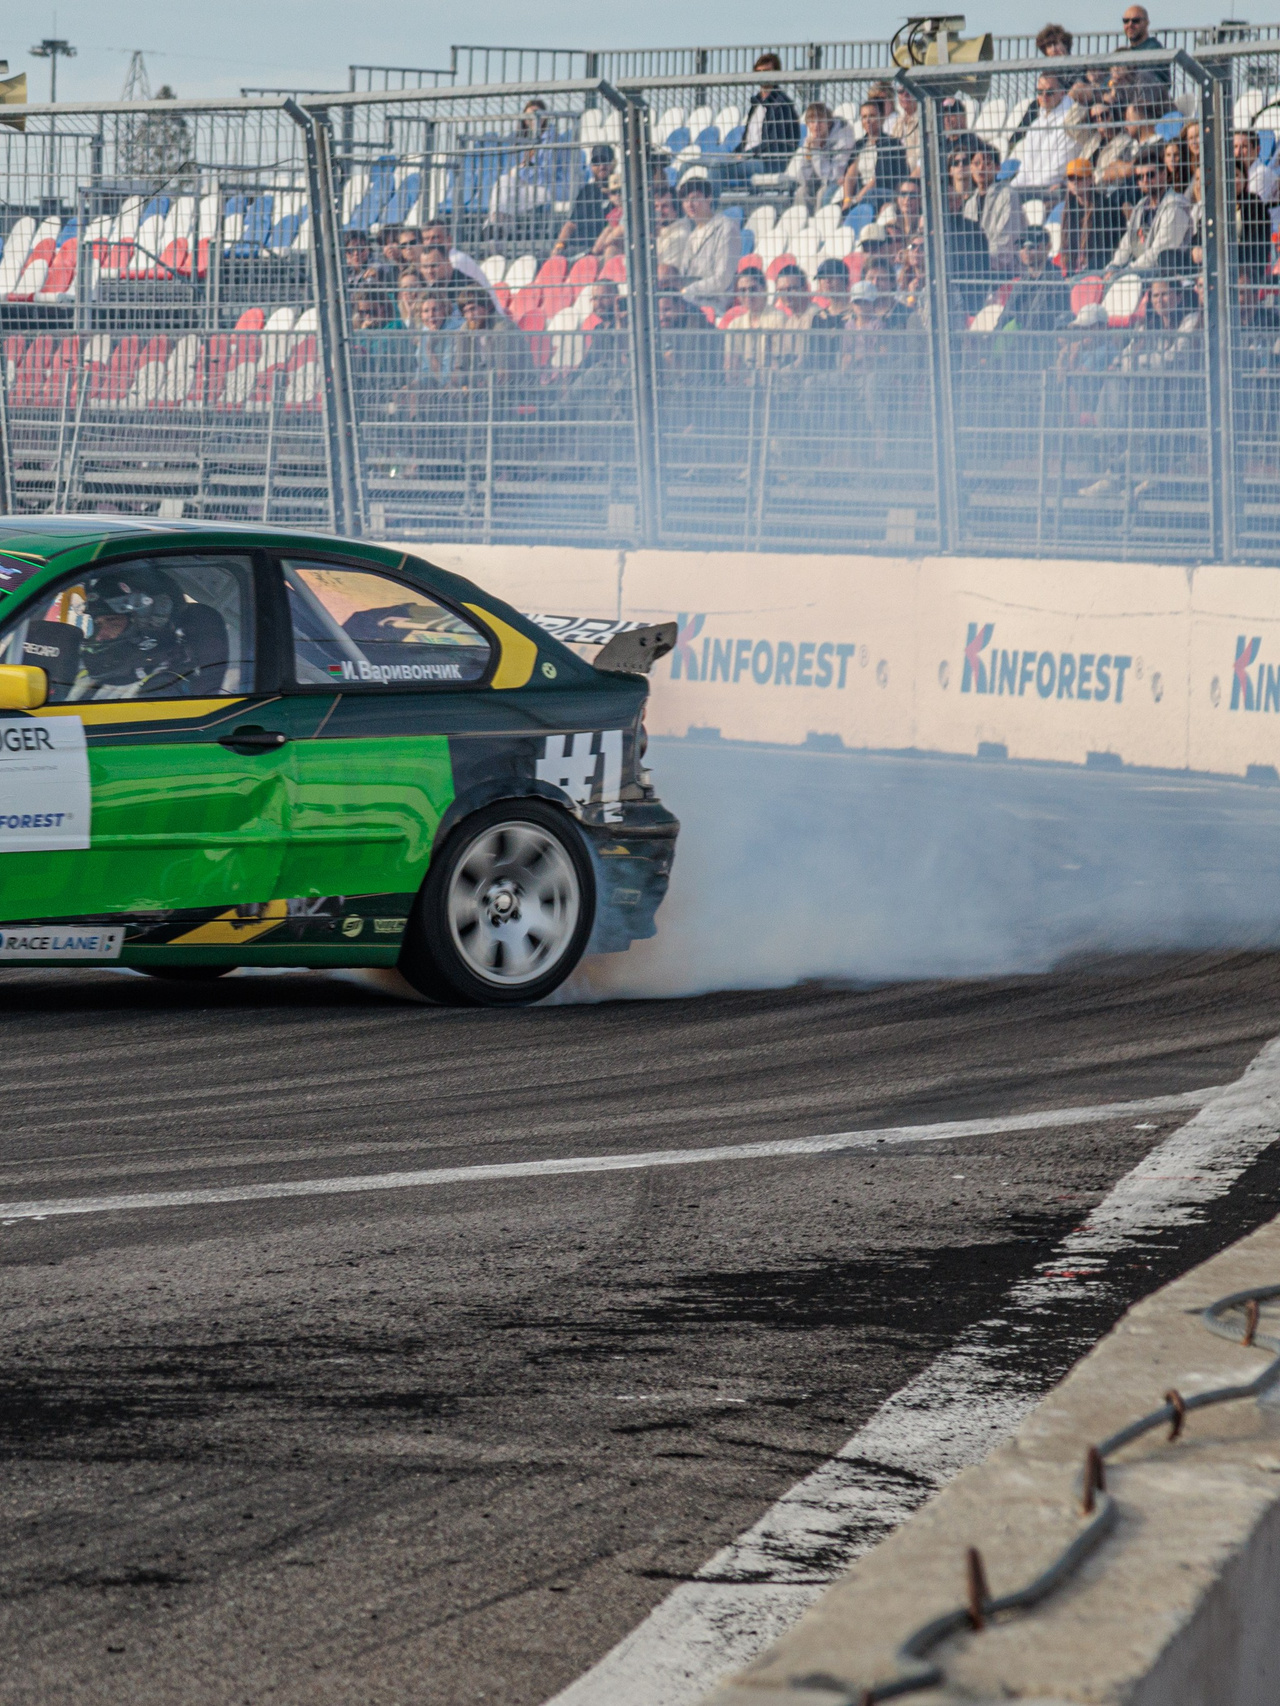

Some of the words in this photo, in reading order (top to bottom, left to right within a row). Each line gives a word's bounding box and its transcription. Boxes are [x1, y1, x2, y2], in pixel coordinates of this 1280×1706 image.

[670, 612, 855, 689] KINFOREST
[961, 622, 1132, 704] KINFOREST
[5, 936, 50, 950] RACE
[52, 936, 99, 950] LANE
